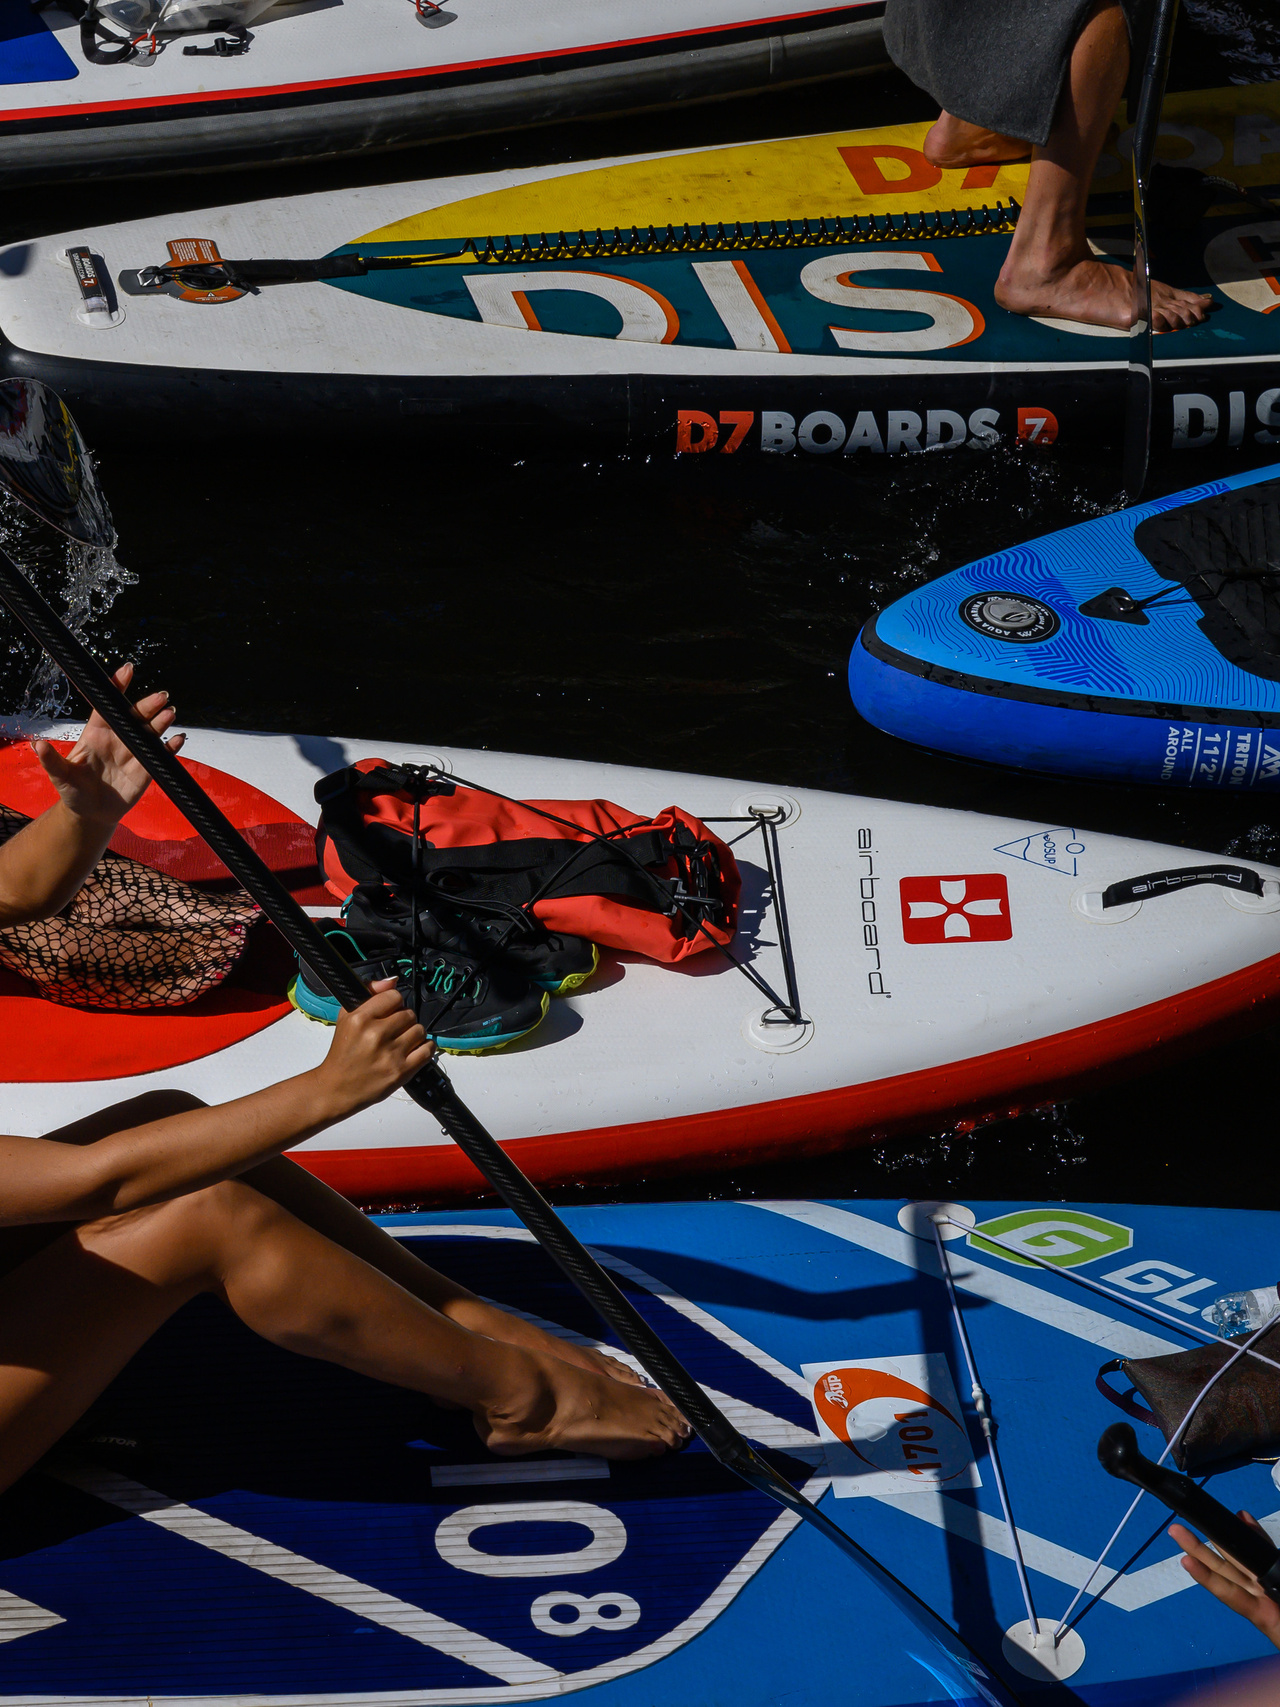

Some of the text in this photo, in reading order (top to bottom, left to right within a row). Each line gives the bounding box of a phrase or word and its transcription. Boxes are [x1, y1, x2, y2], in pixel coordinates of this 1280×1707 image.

[981, 622, 1011, 636] AQUA
[1160, 726, 1180, 781] AROUND
[1181, 727, 1194, 753] ALL
[1229, 732, 1252, 785] TRITON
[1131, 873, 1243, 894] airboard
[858, 828, 891, 995] airboard
[1100, 1259, 1219, 1324] GL
[894, 1411, 943, 1475] 1701
